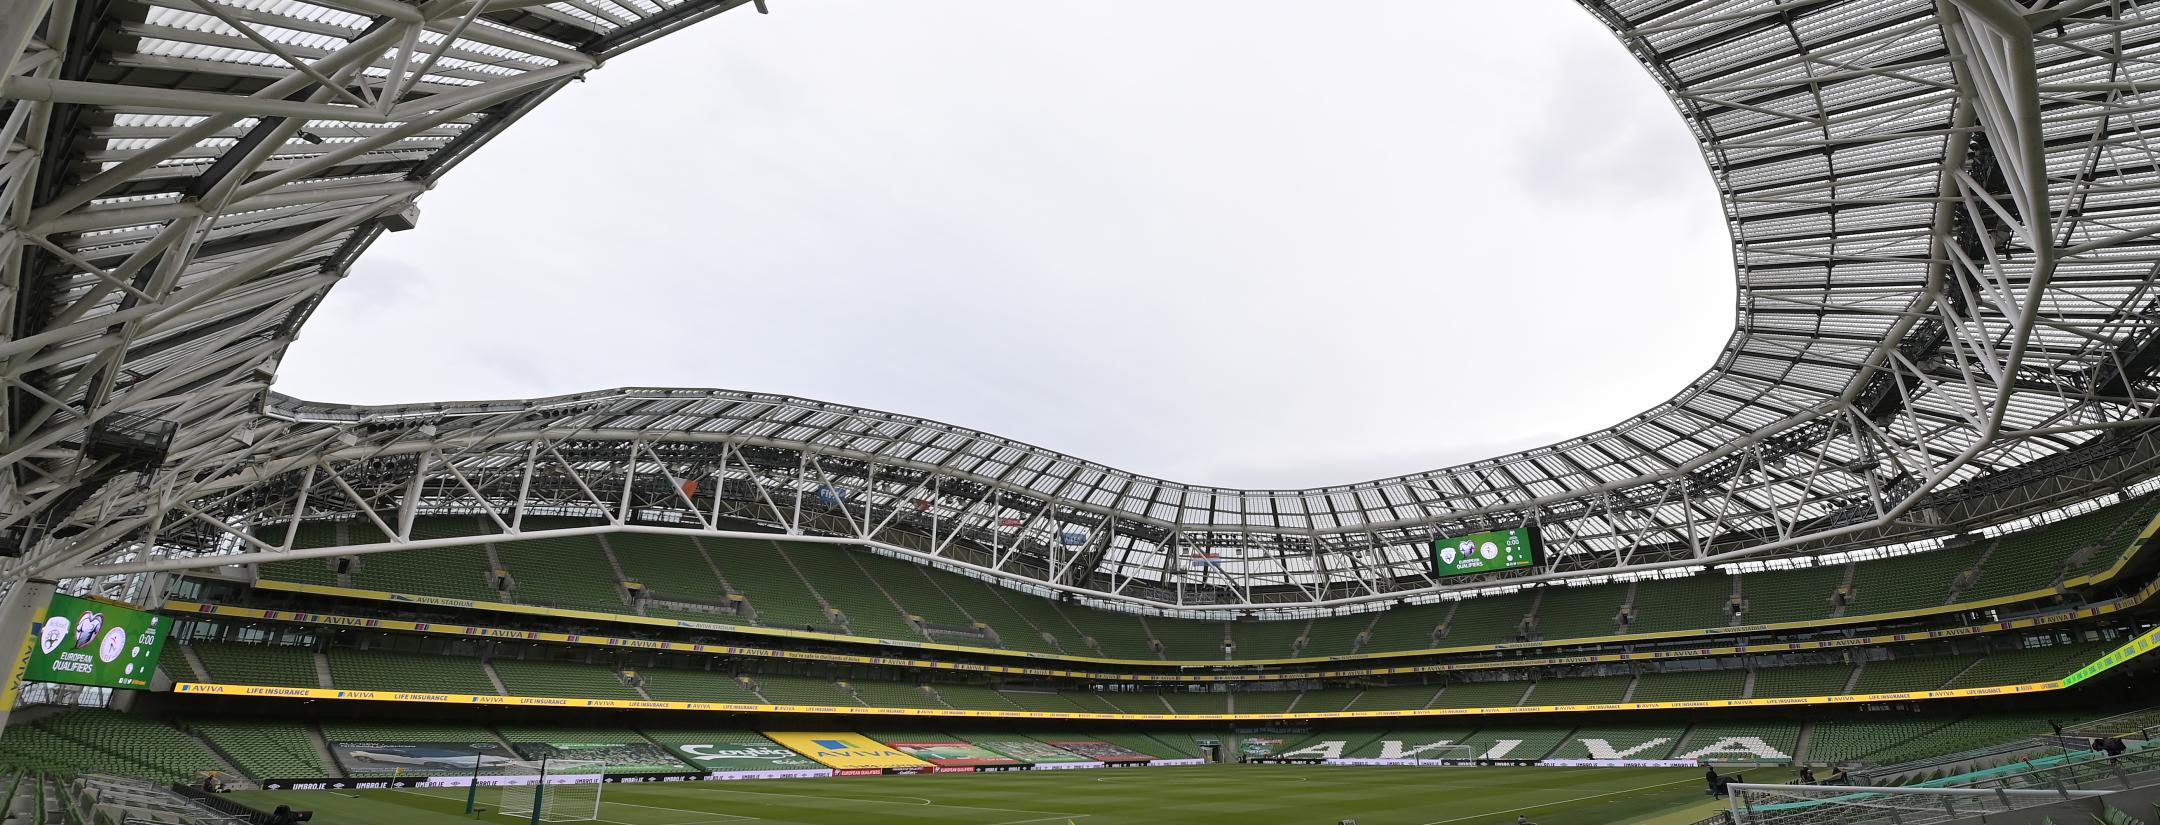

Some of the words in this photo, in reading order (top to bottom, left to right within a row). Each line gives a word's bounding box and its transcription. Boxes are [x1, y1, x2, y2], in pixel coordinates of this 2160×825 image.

[416, 596, 440, 605] AVIVA
[441, 599, 473, 608] STADIUM
[323, 616, 362, 626] AVIVA
[2047, 614, 2069, 624] AVIVA
[1741, 624, 1768, 632] STADIUM
[1945, 626, 1970, 636] AVIVA
[139, 633, 155, 645] 0:00
[491, 629, 523, 639] AVIVA
[630, 640, 657, 648] AVIVA
[60, 651, 93, 663] EUROPEAN
[10, 645, 32, 691] AVIVA
[52, 660, 93, 673] QUALIFIERS
[192, 685, 224, 693] AVIVA
[265, 688, 309, 696] INSURANCE
[356, 782, 388, 790] UMBRO.IE
[415, 781, 445, 789] UMBRO.IE
